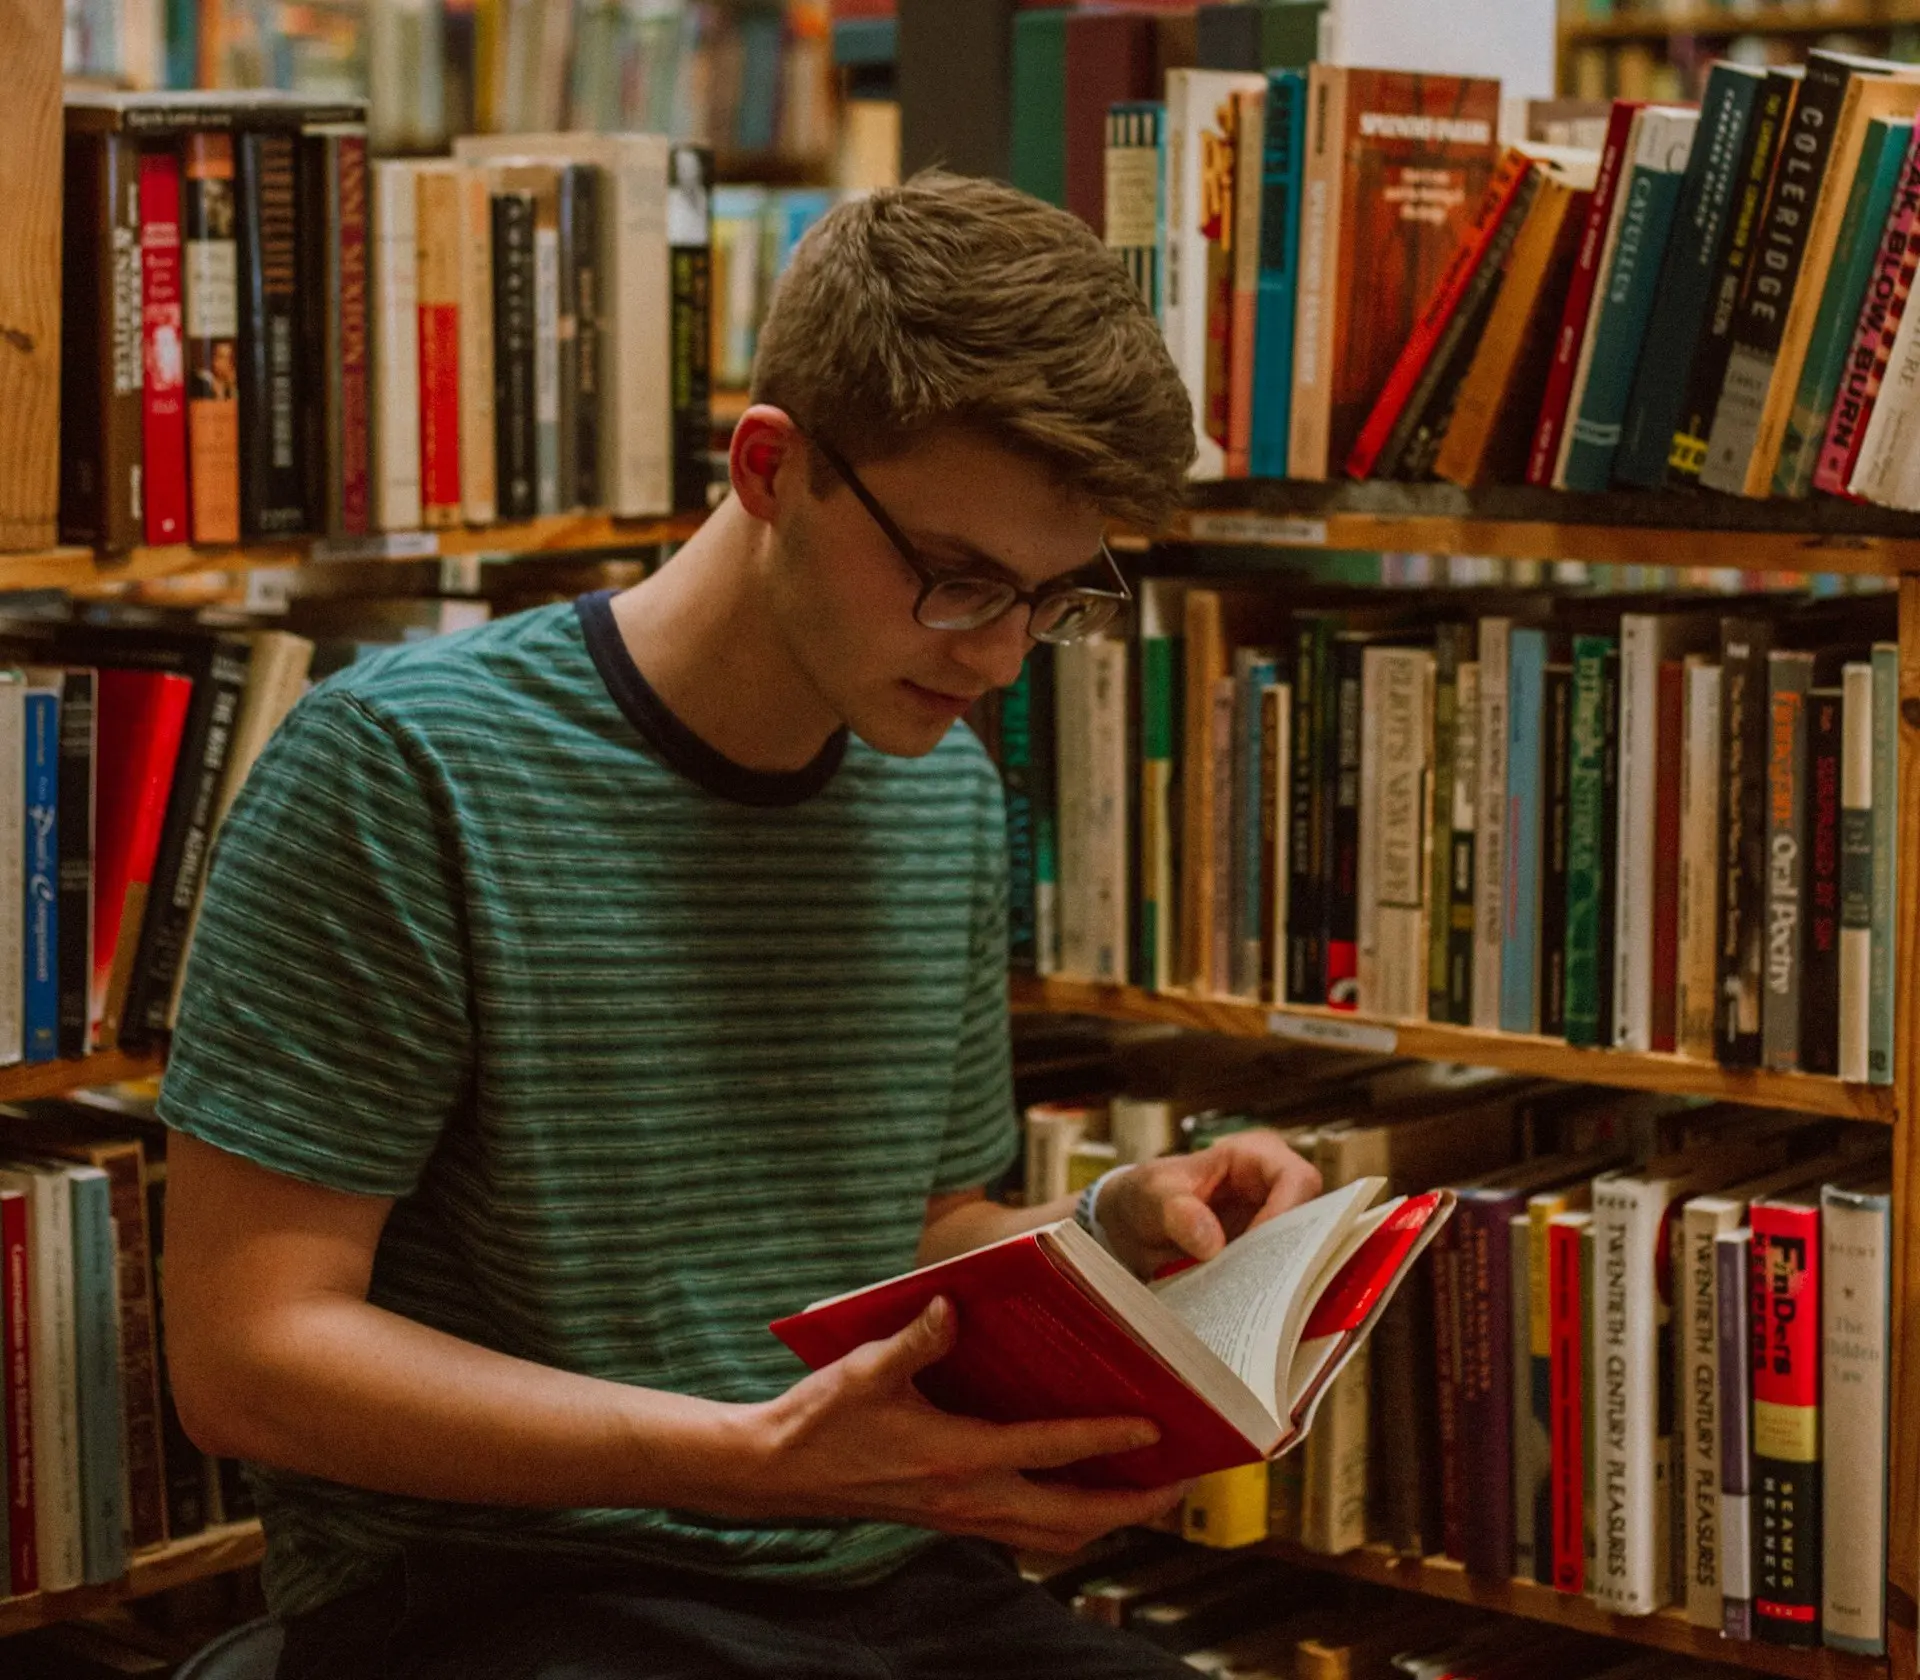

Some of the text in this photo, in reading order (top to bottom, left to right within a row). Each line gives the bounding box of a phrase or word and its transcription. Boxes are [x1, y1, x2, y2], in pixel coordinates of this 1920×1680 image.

[1751, 104, 1824, 323] COLERIDGE
[1860, 229, 1907, 334] BLOW,
[1833, 347, 1875, 448] BURN
[1770, 834, 1798, 897] Oral
[1769, 902, 1797, 994] Poetry
[1607, 1221, 1627, 1347] TWENTIETH
[1607, 1353, 1627, 1453] CENTURY
[1695, 1233, 1716, 1587] TWENTIETH CENTURY PLEASURES
[1607, 1459, 1627, 1577] PLEASURES
[1764, 1477, 1776, 1587] HEANEY
[1781, 1481, 1794, 1589] SEAMUS
